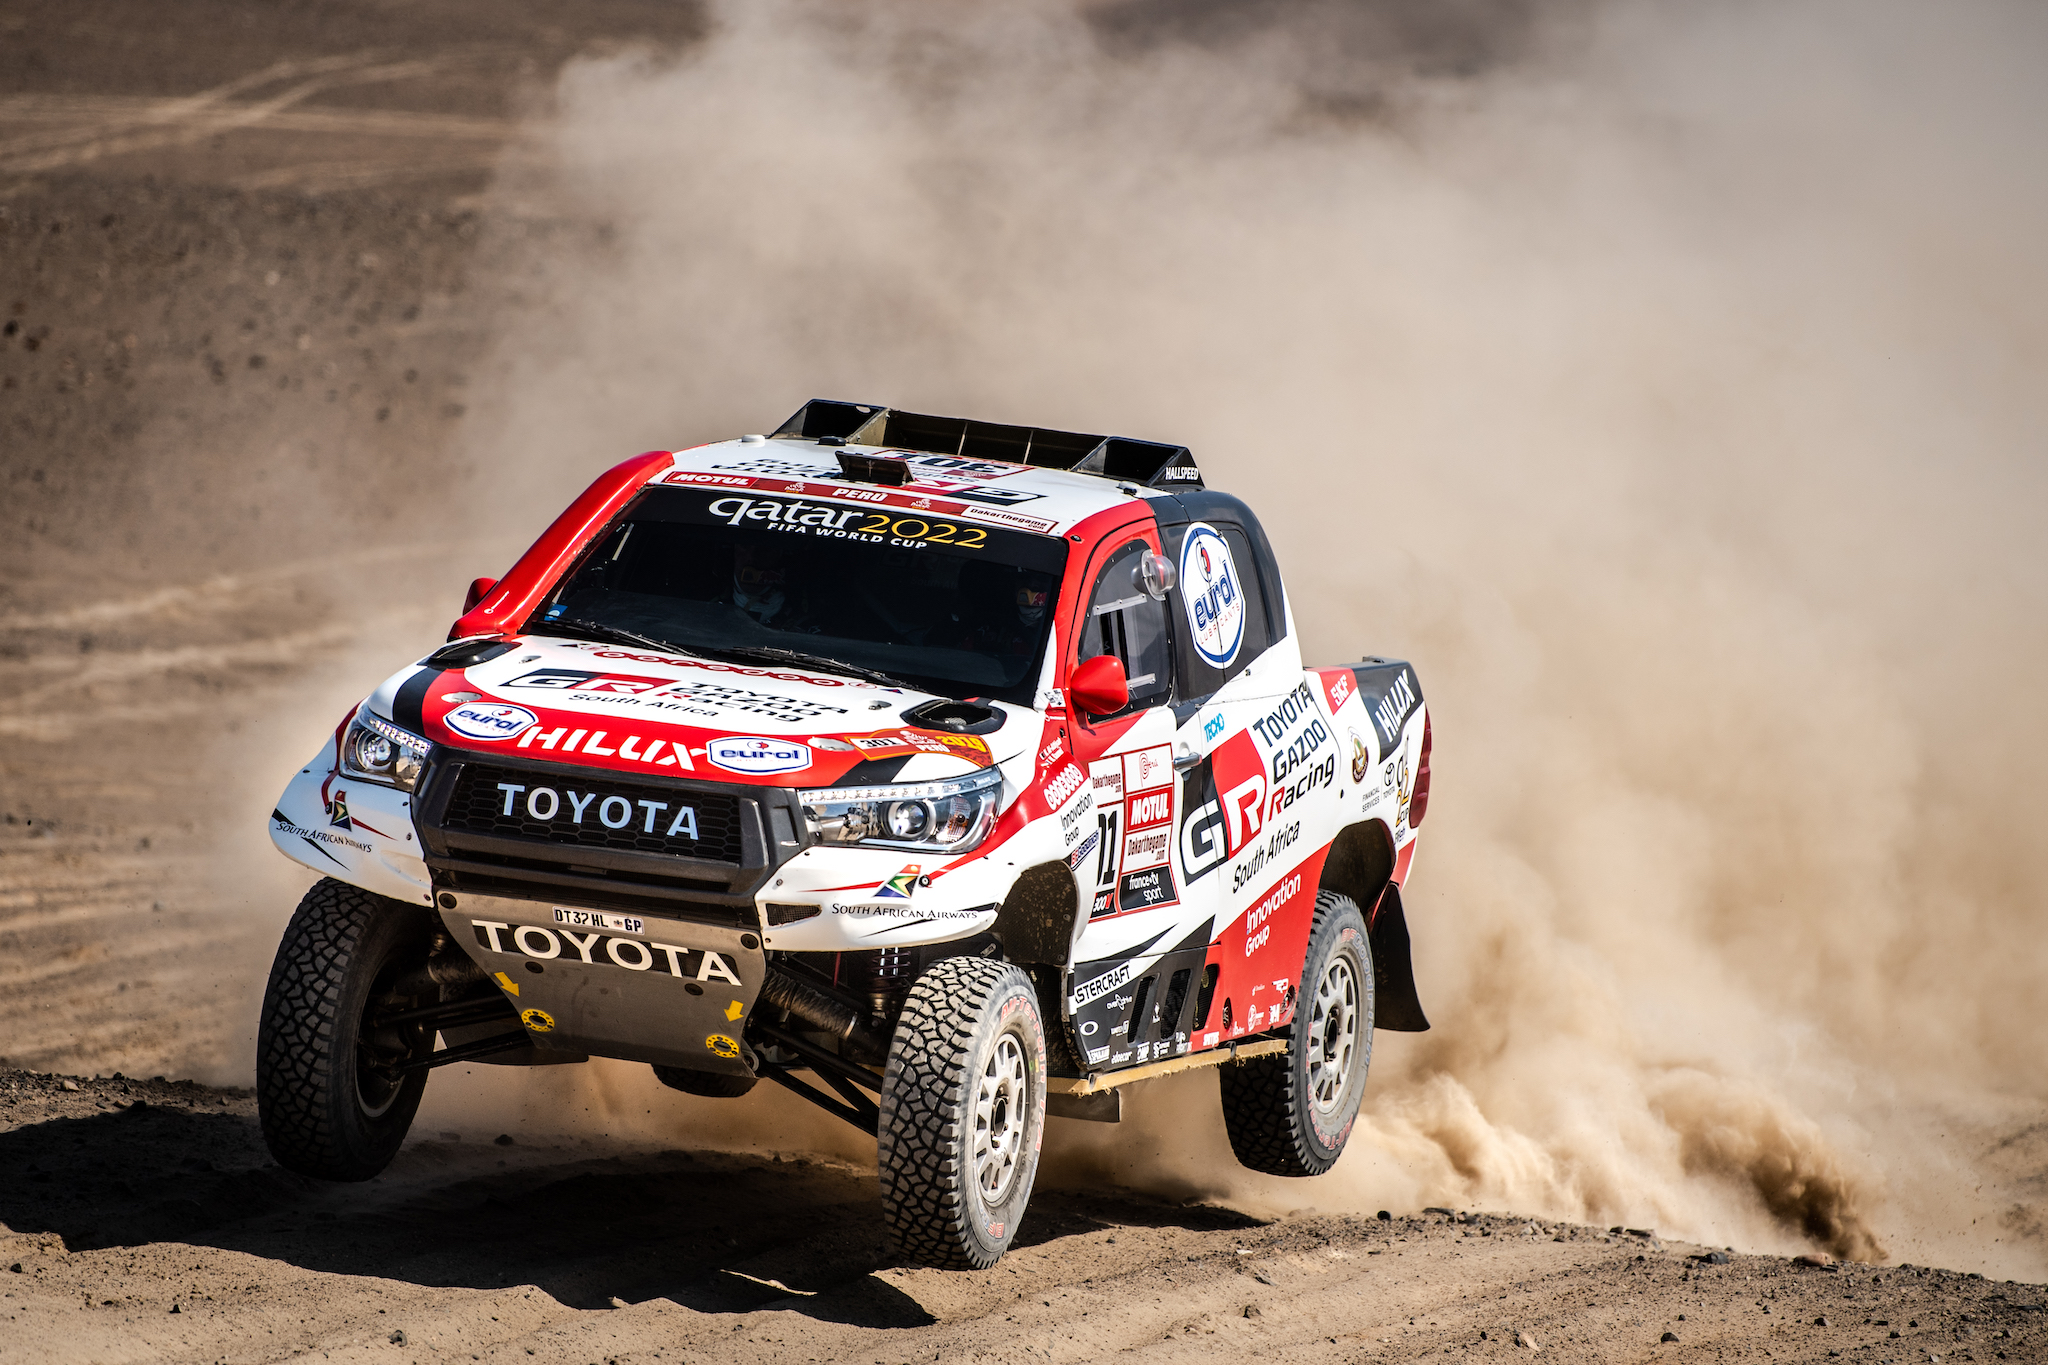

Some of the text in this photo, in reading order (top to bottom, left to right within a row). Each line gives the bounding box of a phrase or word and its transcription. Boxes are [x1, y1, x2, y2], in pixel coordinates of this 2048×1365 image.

[672, 473, 750, 486] MOTUL
[1165, 466, 1199, 480] HALLSPEED
[766, 522, 928, 549] FIFA WORLD CUP
[1193, 559, 1237, 631] eurol
[507, 674, 656, 695] GR
[691, 682, 849, 714] TOYOTA
[1329, 673, 1350, 707] SKF
[569, 693, 719, 717] South Africa
[654, 691, 804, 722] Racing
[670, 687, 821, 716] GAZOO
[1252, 680, 1316, 748] TOYOTA
[1374, 668, 1416, 743] HILUX
[457, 709, 524, 731] eurol
[517, 726, 708, 771] HILUX
[719, 749, 800, 760] eurol
[860, 738, 900, 748] 301
[935, 735, 987, 753] 2019
[1272, 718, 1327, 785] GAZOO
[1267, 753, 1335, 823] Racing
[497, 783, 699, 840] TOYOTA
[1060, 792, 1094, 831] Innovation
[1130, 792, 1169, 826] MOTUL
[1180, 774, 1266, 876] GR
[1064, 826, 1080, 847] Group
[1127, 833, 1167, 857] Dakarthegame
[1232, 820, 1300, 895] South Africa
[1142, 886, 1164, 905] sport
[1246, 873, 1302, 935] Innovation
[471, 919, 743, 987] TOYOTA
[1245, 925, 1270, 957] Group
[1075, 964, 1131, 1004] STERCRAFT
